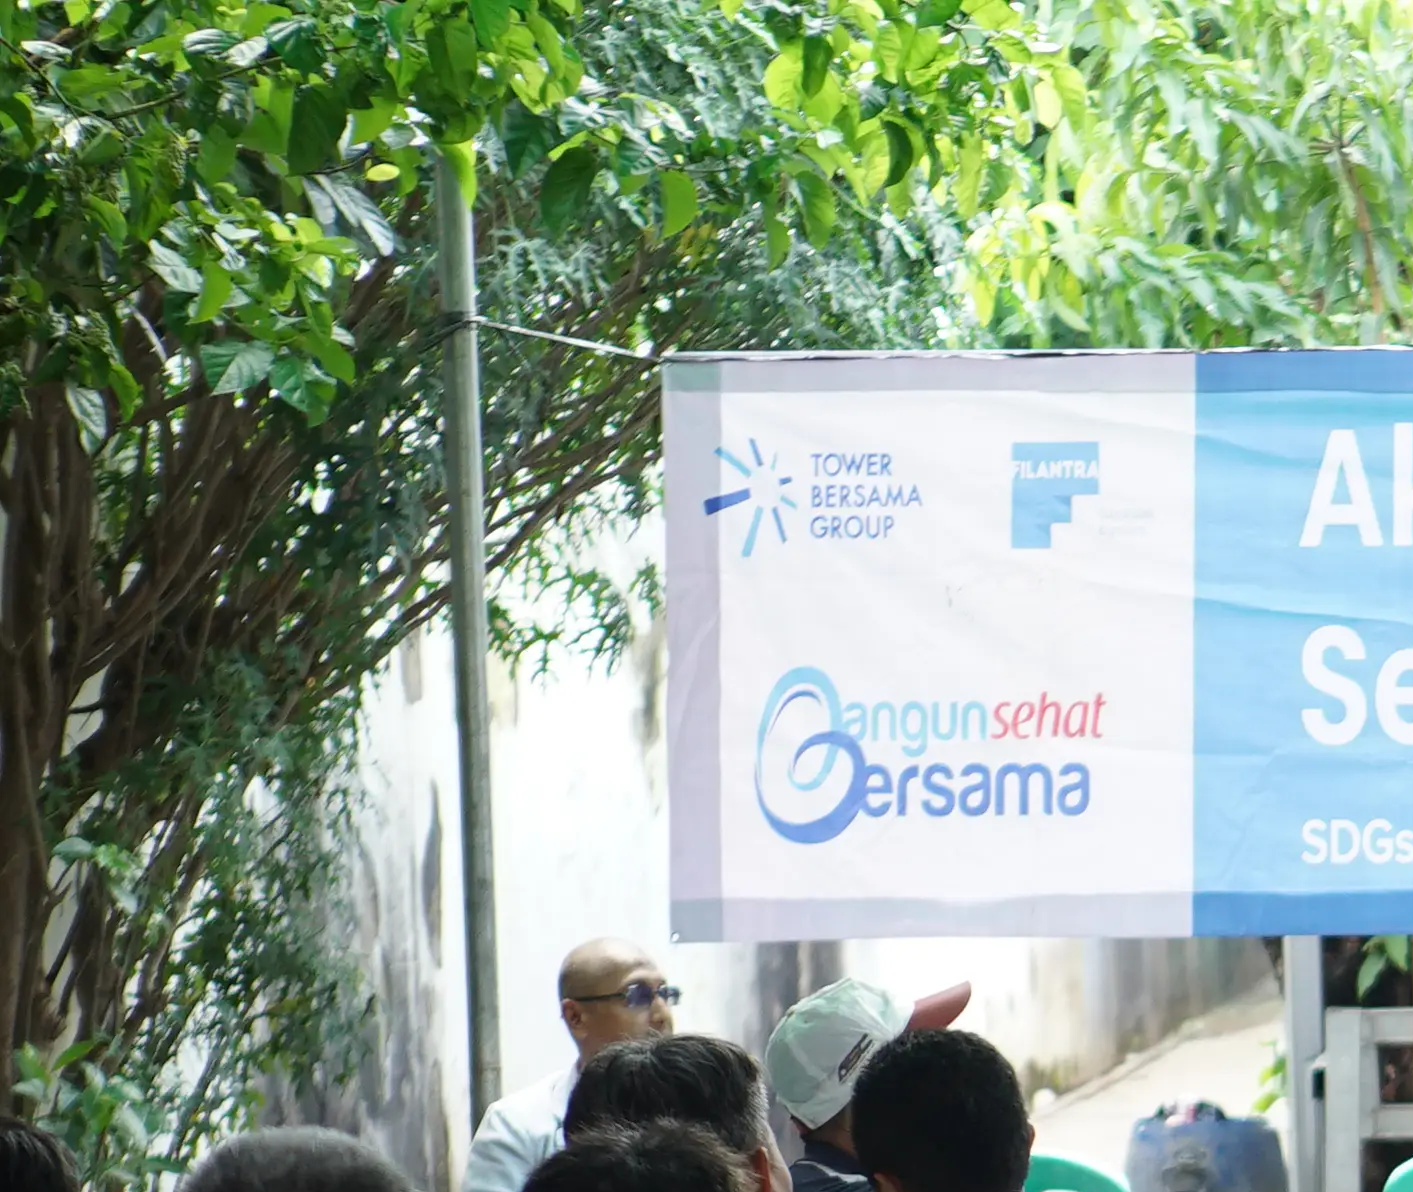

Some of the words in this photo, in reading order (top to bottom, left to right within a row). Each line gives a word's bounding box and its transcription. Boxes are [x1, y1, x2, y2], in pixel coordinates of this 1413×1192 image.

[811, 452, 892, 477] TOWER
[1012, 460, 1100, 479] FILANTRA
[811, 485, 922, 508] BERSAMA
[810, 516, 894, 539] GROUP
